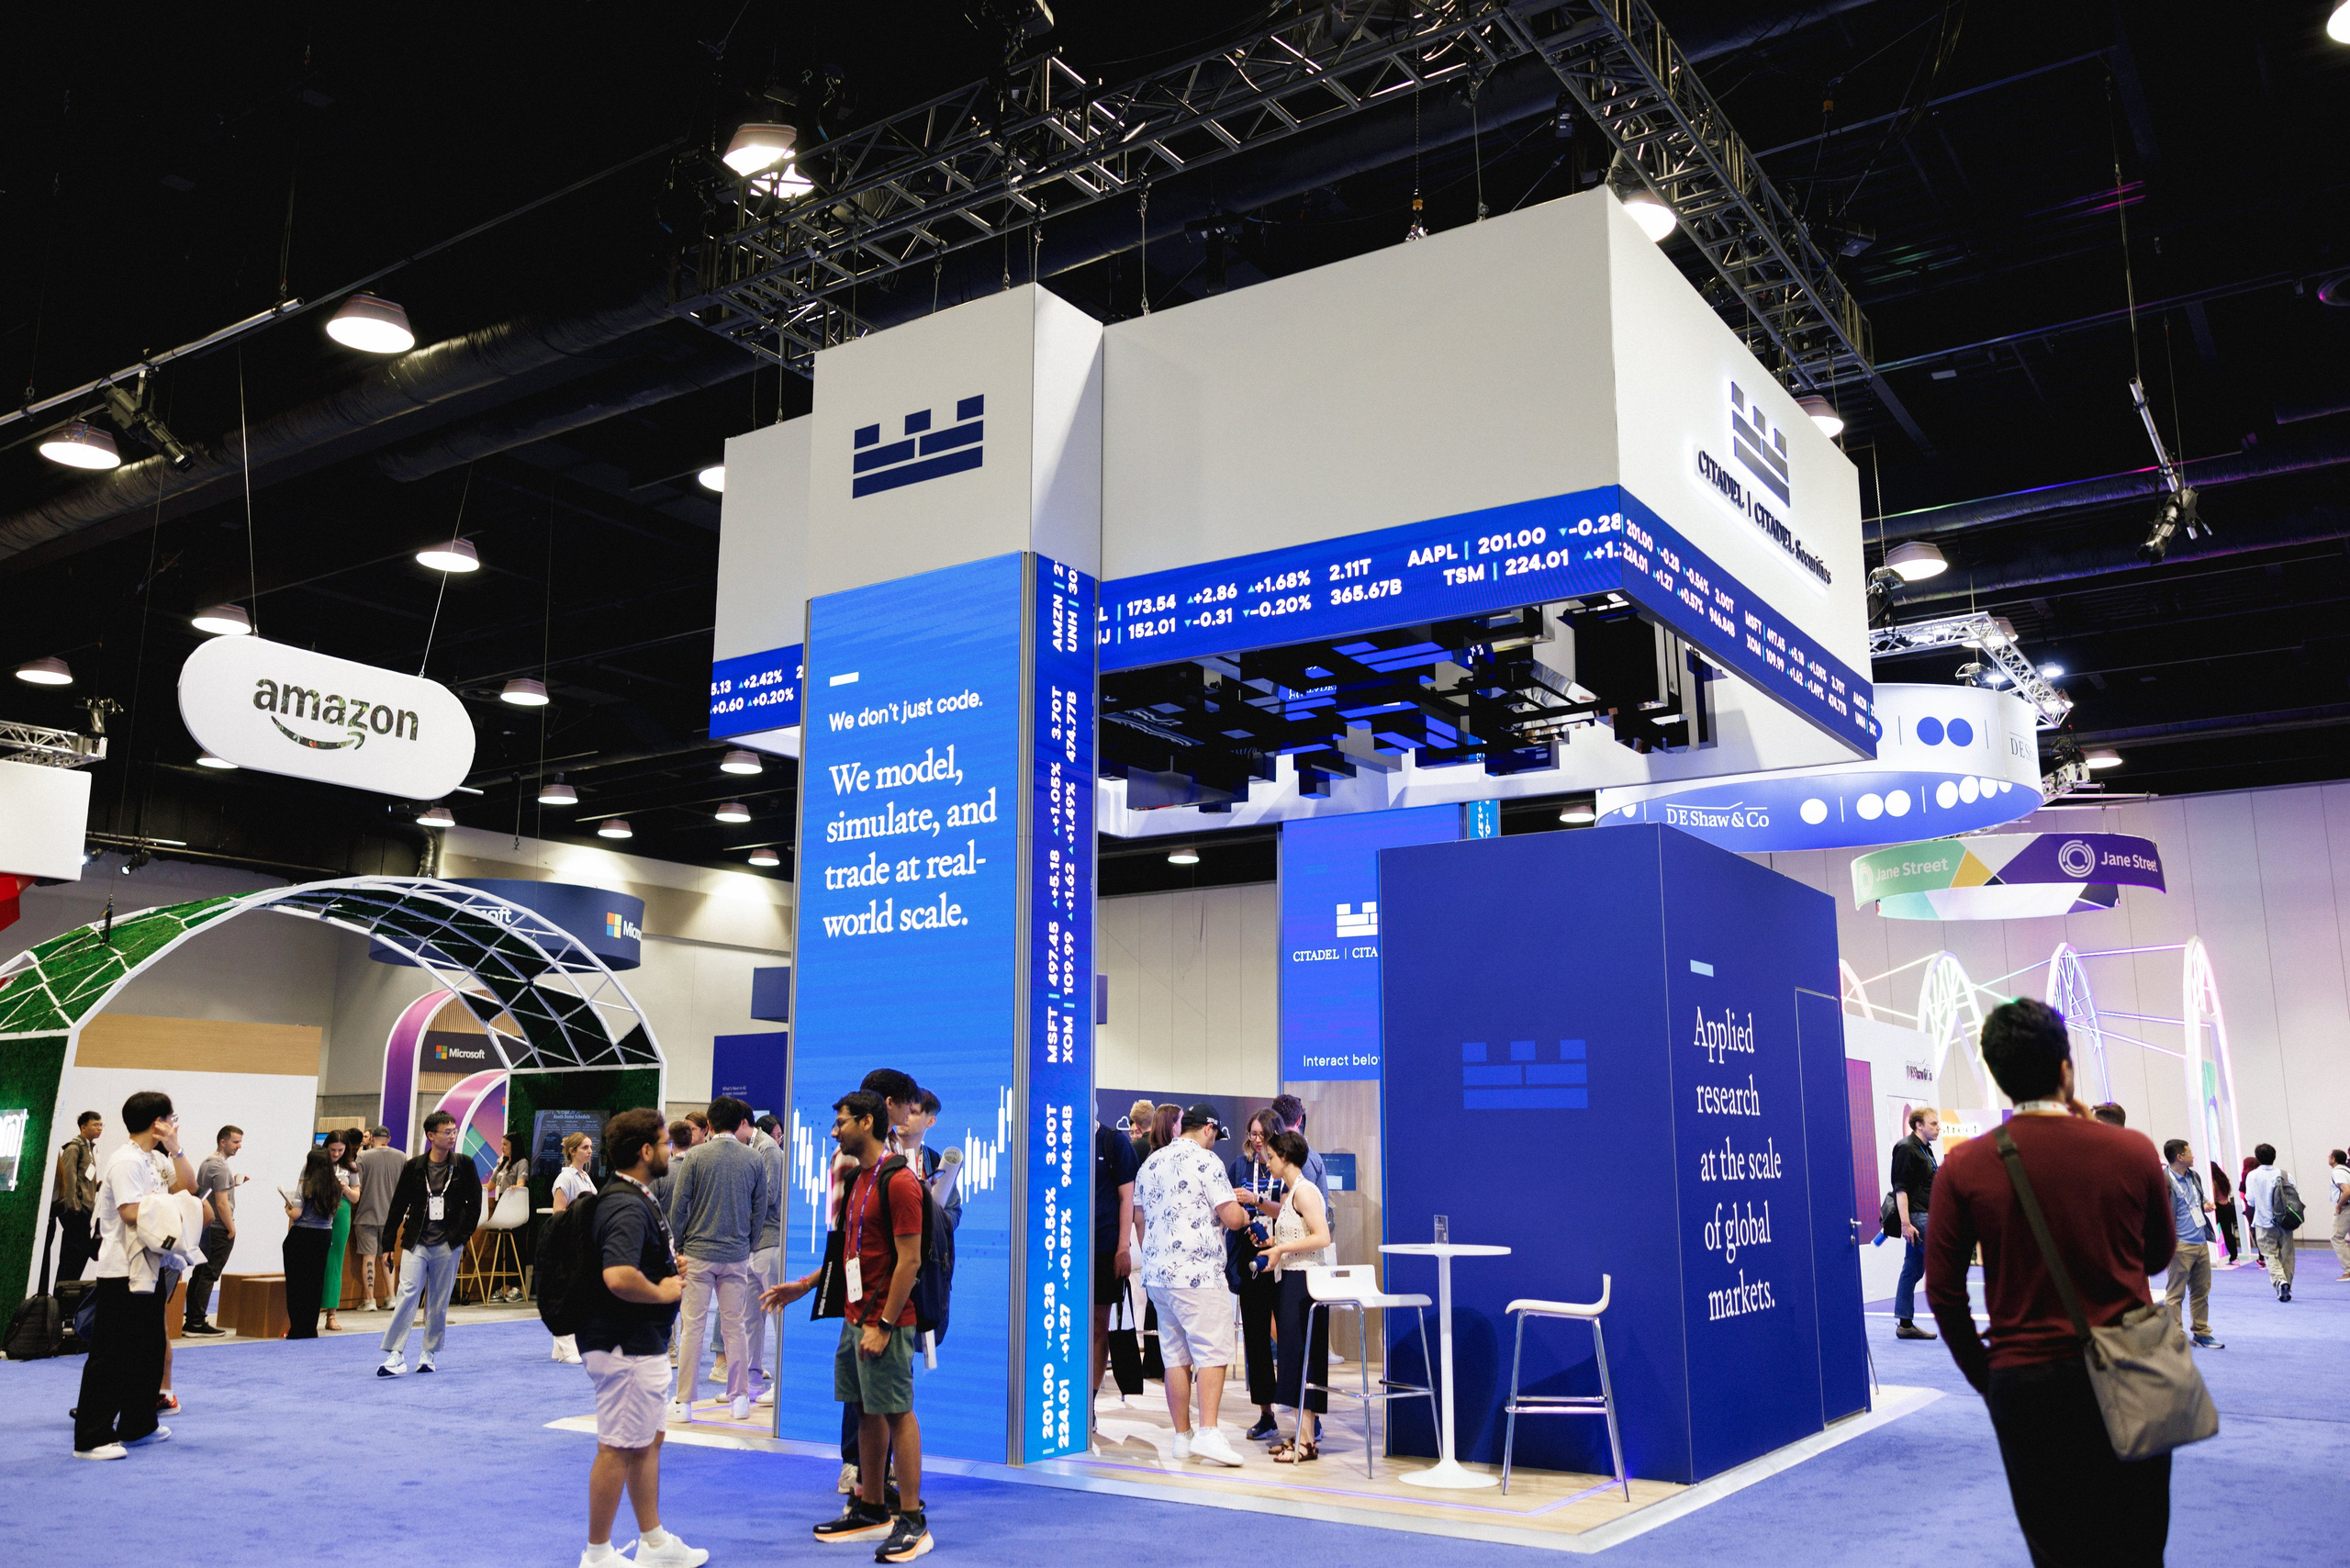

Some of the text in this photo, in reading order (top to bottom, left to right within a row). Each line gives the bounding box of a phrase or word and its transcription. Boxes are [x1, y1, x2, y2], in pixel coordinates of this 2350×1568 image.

[1698, 451, 1744, 509] CITADEL
[1754, 502, 1795, 554] CITADEL
[1127, 594, 1176, 617] 173.54
[1193, 583, 1237, 604] +2.86
[1255, 570, 1311, 593] +1.68%
[1329, 558, 1371, 581] 2.11T
[1407, 543, 1458, 567] AAPL
[1478, 527, 1546, 554] 201.00
[1569, 512, 1620, 536] -0.28
[1128, 618, 1175, 640] 152.01
[1192, 608, 1233, 628] -0.31
[1250, 595, 1311, 618] -0.20%
[1331, 578, 1402, 606] 365.67B
[1443, 564, 1484, 586] TSM
[1505, 550, 1569, 577] 224.01
[1594, 541, 1621, 559] +1.
[1627, 519, 1652, 553] 201.00
[1715, 588, 1734, 614] 3.00T
[1745, 610, 1762, 634] MSFT
[1767, 628, 1785, 652] 497.45
[1053, 594, 1063, 652] AMZN
[1623, 543, 1648, 575] 224.01
[1709, 607, 1735, 637] 946.84B
[1747, 633, 1761, 656] XOM
[1068, 612, 1078, 653] UNH
[712, 688, 794, 714] +0.60 +0.20%
[744, 669, 782, 689] +2.42%
[253, 678, 419, 741] amazon
[829, 689, 983, 732] We don't just code.
[1051, 686, 1062, 740] 3.70T
[1066, 691, 1077, 763] 474.77B
[829, 745, 963, 796] We model,
[1050, 762, 1061, 826] +1.05%
[826, 787, 997, 843] simulate, and
[1065, 781, 1075, 844] +1.49%
[1690, 810, 1729, 827] Shaw
[1746, 812, 1769, 827] Co
[825, 839, 986, 890] trade at real-
[1049, 849, 1059, 899] +5.18
[1065, 862, 1075, 911] +1.62
[1876, 858, 1949, 881] Jane Street
[2100, 851, 2158, 872] Jane Street
[822, 892, 968, 938] world scale.
[1048, 921, 1059, 987] 497.45
[1064, 931, 1074, 995] 109.99
[1292, 946, 1378, 962] CITADEL CITA
[449, 1048, 485, 1059] Microsoft
[1047, 1006, 1058, 1063] MSFT
[1063, 1016, 1074, 1063] XOM
[1304, 1054, 1380, 1067] Interact belo
[1694, 1005, 1754, 1064] Applied
[1696, 1073, 1761, 1116] research
[1046, 1103, 1057, 1165] 3.00T
[1061, 1104, 1072, 1188] 946.84B
[1701, 1136, 1782, 1182] at the scale
[1045, 1187, 1056, 1260] -0.56%
[1060, 1208, 1071, 1281] +0.57%
[1705, 1200, 1772, 1264] of global
[1044, 1282, 1055, 1339] -0.28
[1708, 1268, 1775, 1321] markets.
[1059, 1304, 1070, 1354] +1.27
[1043, 1363, 1054, 1439] 201.00
[1058, 1379, 1069, 1449] 224.01
